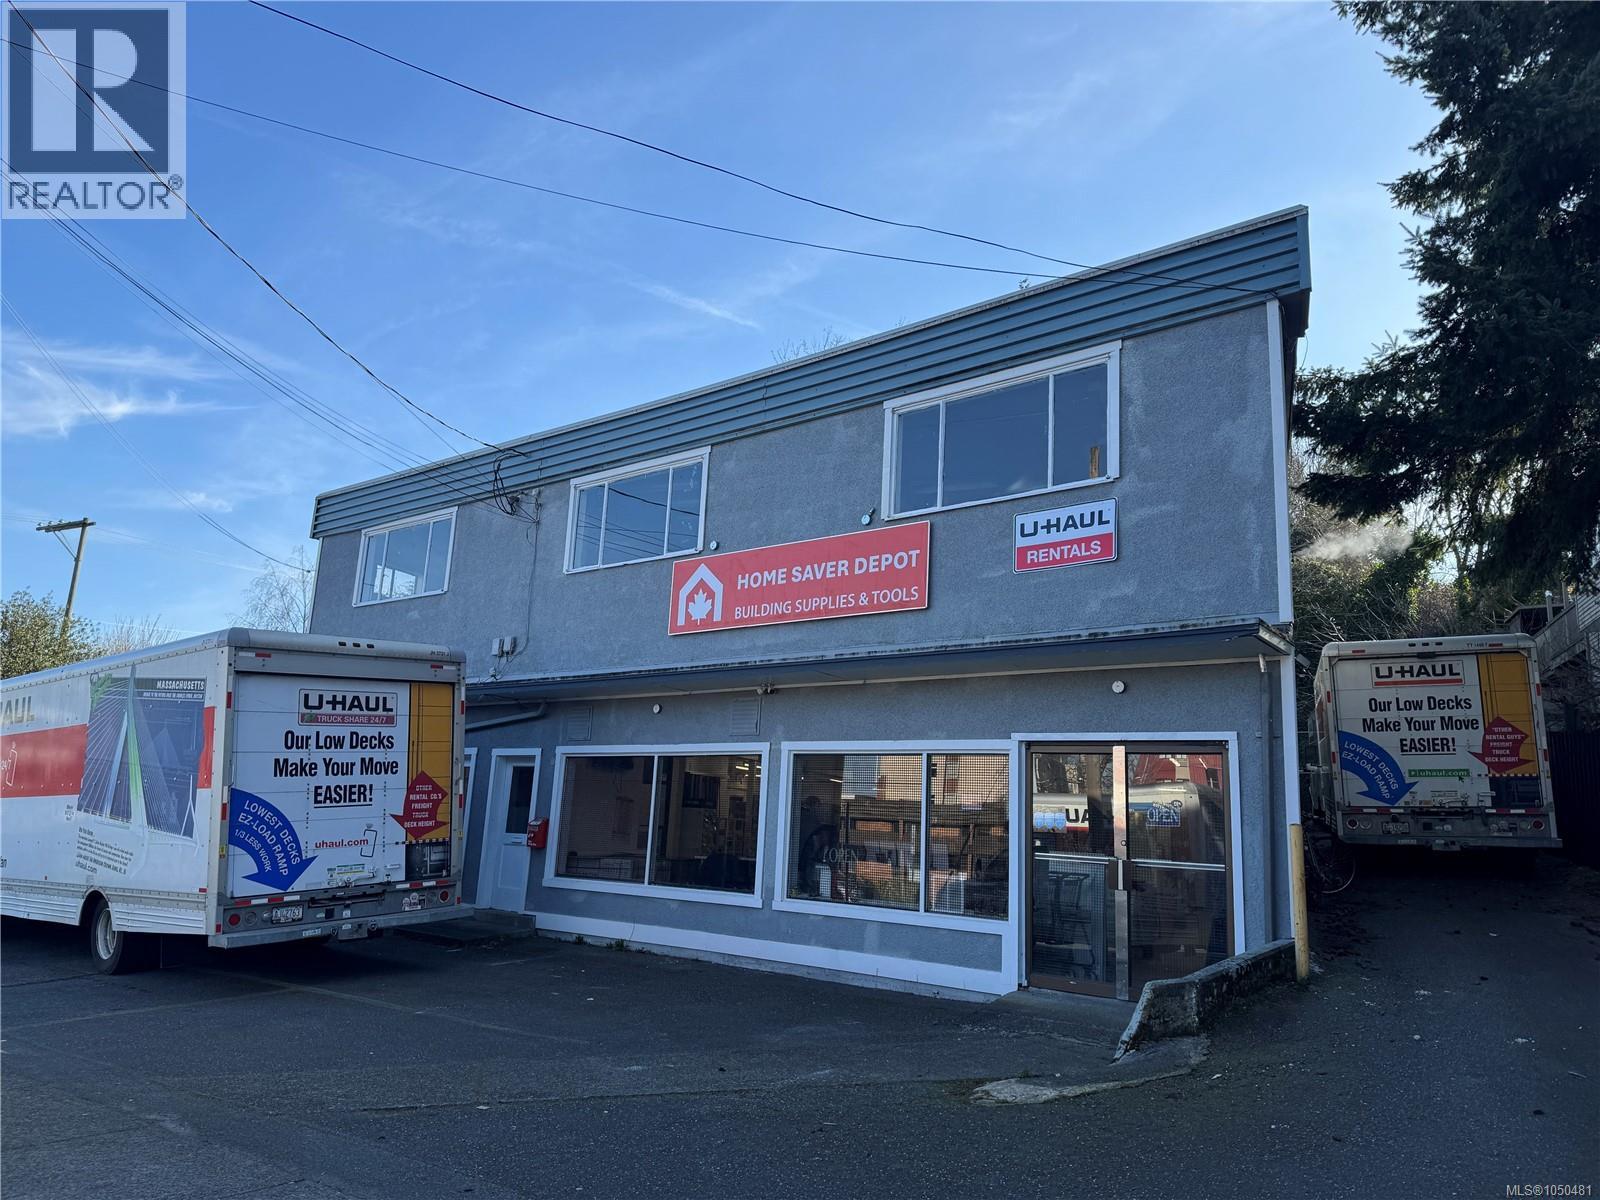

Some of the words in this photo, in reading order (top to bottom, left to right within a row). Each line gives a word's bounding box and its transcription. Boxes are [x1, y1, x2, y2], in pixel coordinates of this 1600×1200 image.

[1020, 510, 1110, 538] U-HAUL
[1027, 541, 1101, 564] RENTALS
[737, 569, 787, 591] HOME
[791, 559, 850, 584] SAVER
[853, 550, 921, 575] DEPOT
[734, 601, 792, 620] BUILDING
[795, 593, 855, 615] SUPPLIES
[858, 592, 869, 606] &
[872, 586, 919, 606] TOOLS
[1375, 663, 1460, 679] U-HAUL
[157, 680, 205, 690] MASSACHUSETTS
[303, 693, 393, 712] U-HAUL
[1368, 697, 1393, 713] Our
[1397, 697, 1423, 712] Low
[1428, 695, 1472, 711] Decks
[317, 714, 342, 723] TRUCK
[344, 715, 369, 723] SHARE
[370, 716, 387, 724] 24/7
[1363, 718, 1401, 733] Make
[1405, 717, 1436, 731] Your
[1440, 716, 1479, 731] Move
[284, 730, 311, 750] Our
[315, 731, 345, 750] Low
[350, 731, 394, 750] Decks
[1400, 737, 1456, 752] EASIER!
[273, 758, 318, 777] Make
[323, 757, 355, 776] Your
[360, 757, 399, 775] Move
[1343, 740, 1380, 766] LOWEST
[1378, 761, 1399, 790] DECKS
[1342, 752, 1377, 777] EZ-LOAD
[1374, 770, 1391, 799] RAMP
[314, 784, 373, 804] EASIER!
[1147, 808, 1178, 822] OPEN
[244, 800, 282, 829] LOWEST
[280, 828, 301, 866] DECKS
[235, 829, 245, 839] 1/3
[244, 833, 261, 851] LESS
[258, 846, 272, 873] WORK
[238, 812, 276, 847] EZ-LOAD
[273, 842, 289, 876] RAMP
[315, 838, 369, 849] uhaul.com
